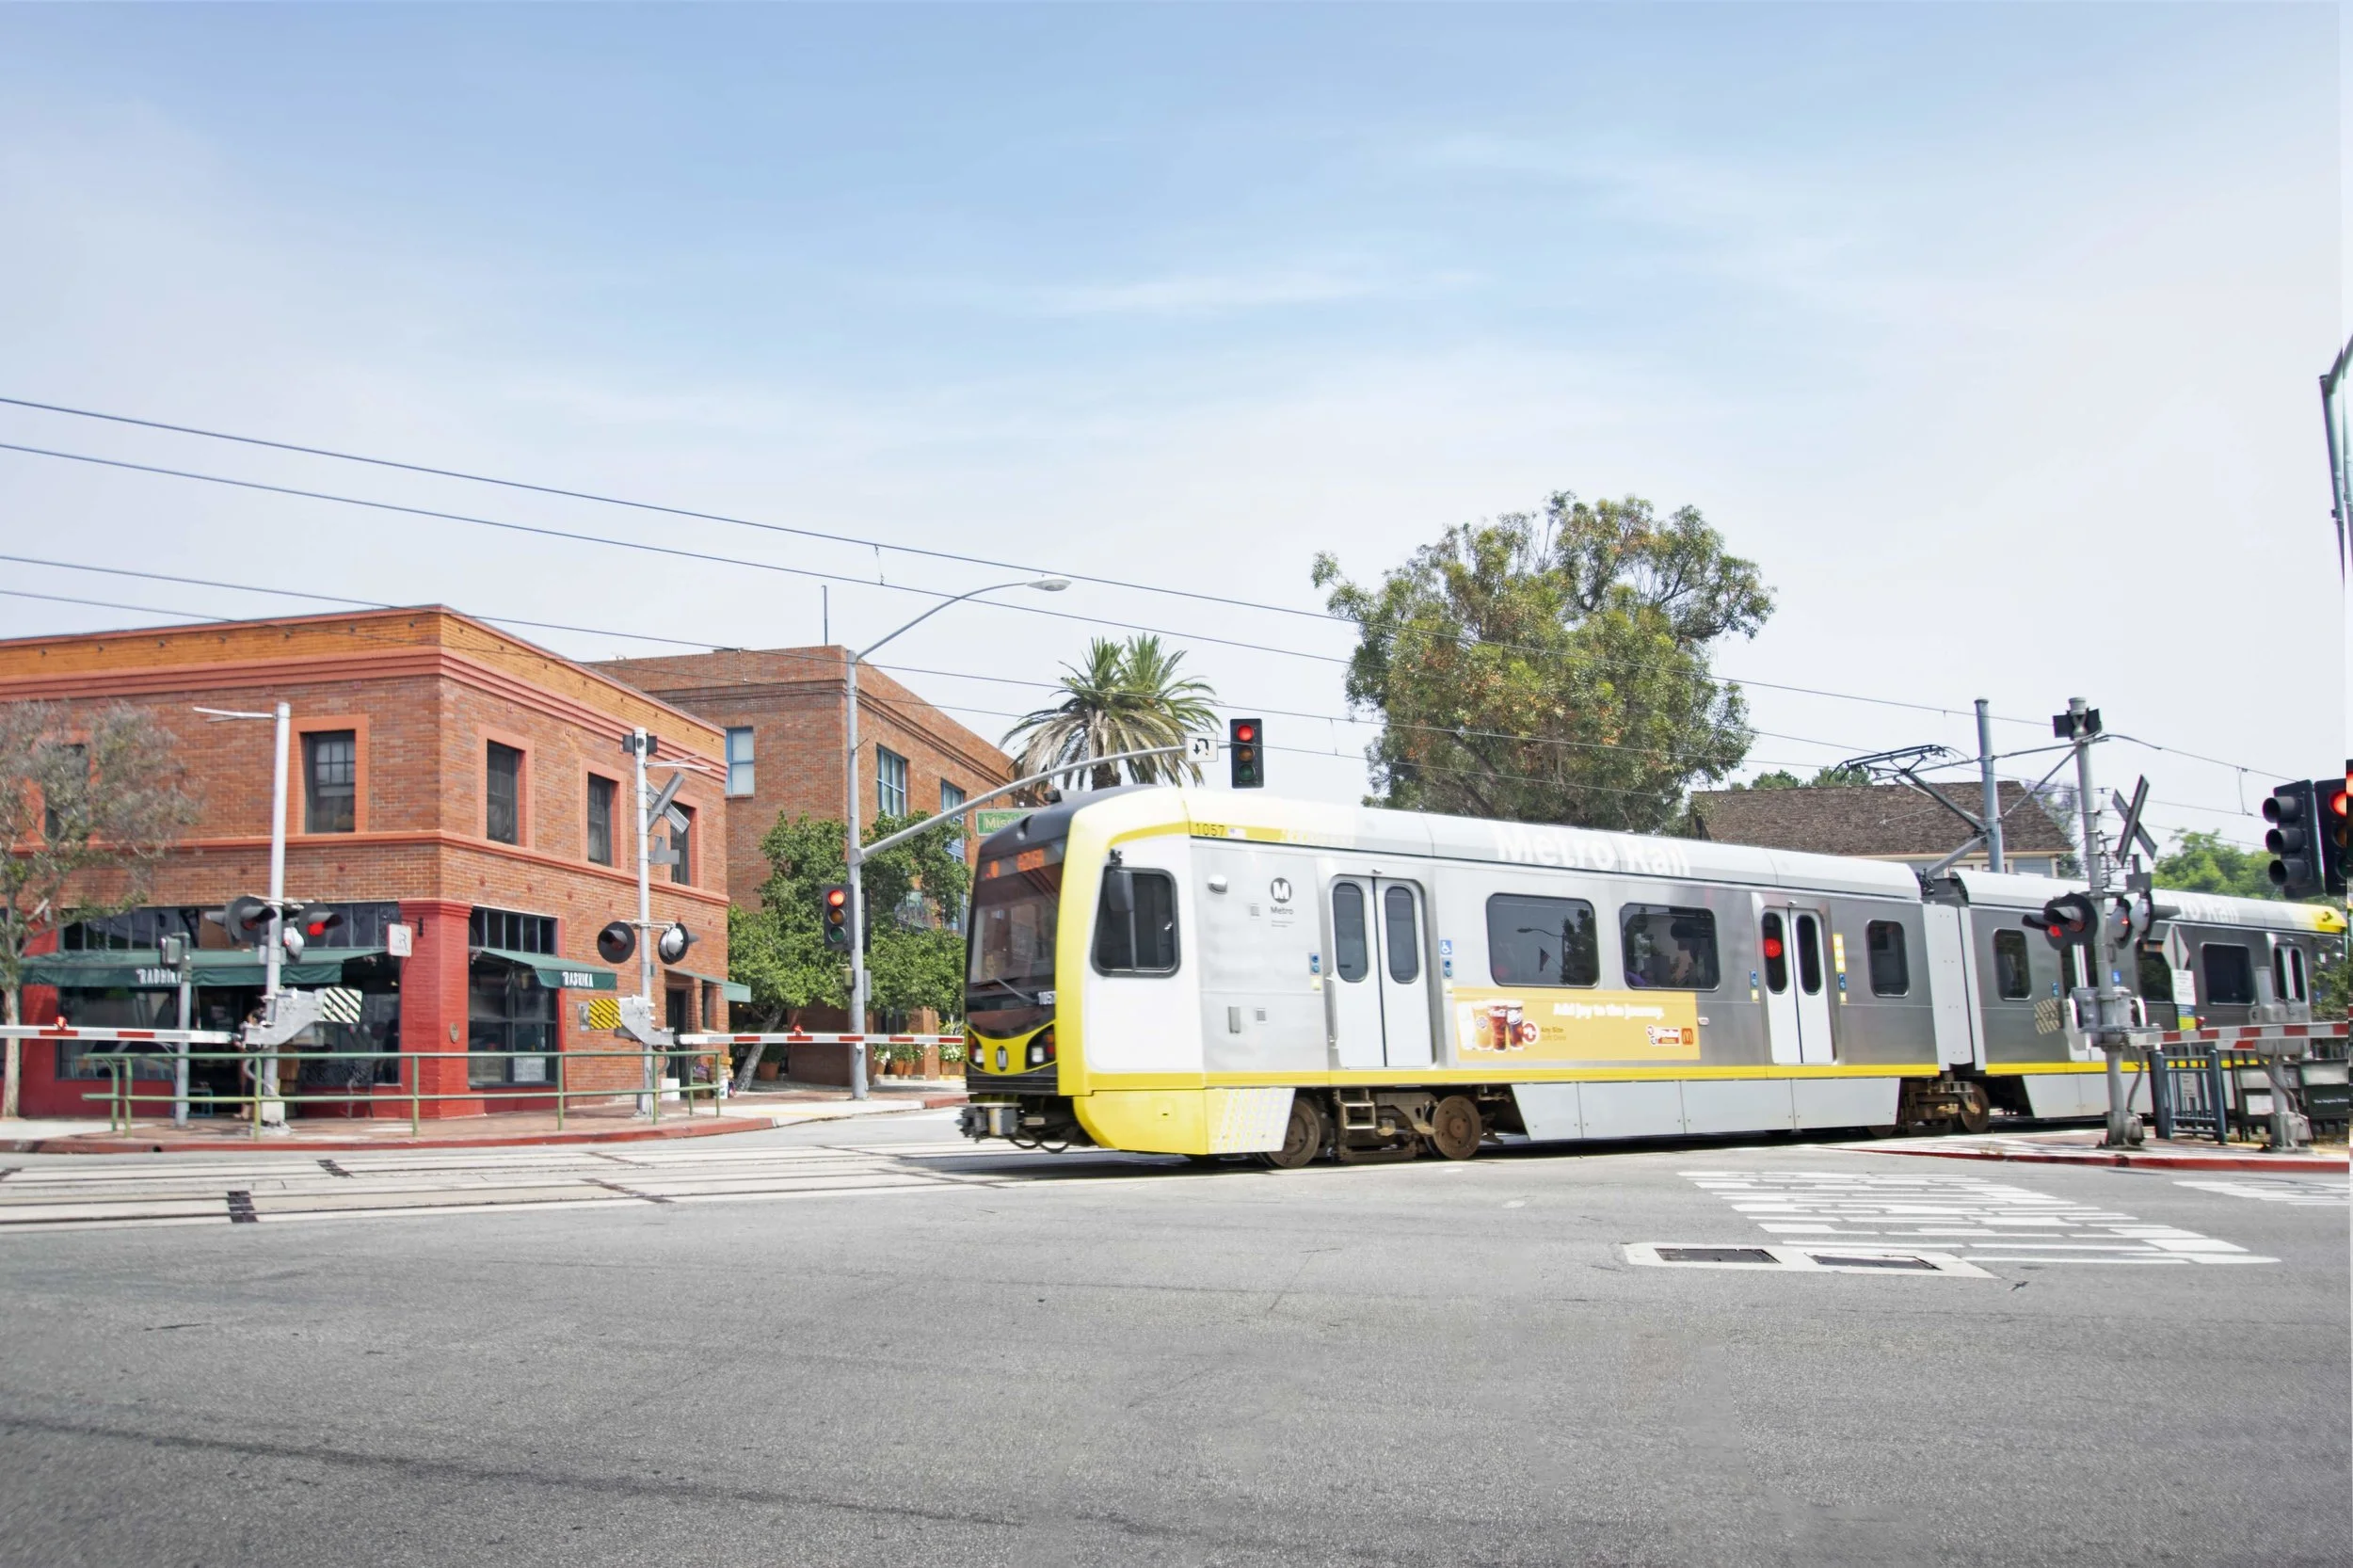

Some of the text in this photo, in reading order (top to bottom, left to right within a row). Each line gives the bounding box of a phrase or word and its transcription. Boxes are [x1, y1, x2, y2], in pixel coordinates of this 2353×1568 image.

[1195, 823, 1225, 837] 1057
[1488, 822, 1691, 876] Metro Rail
[1271, 905, 1294, 915] Metro
